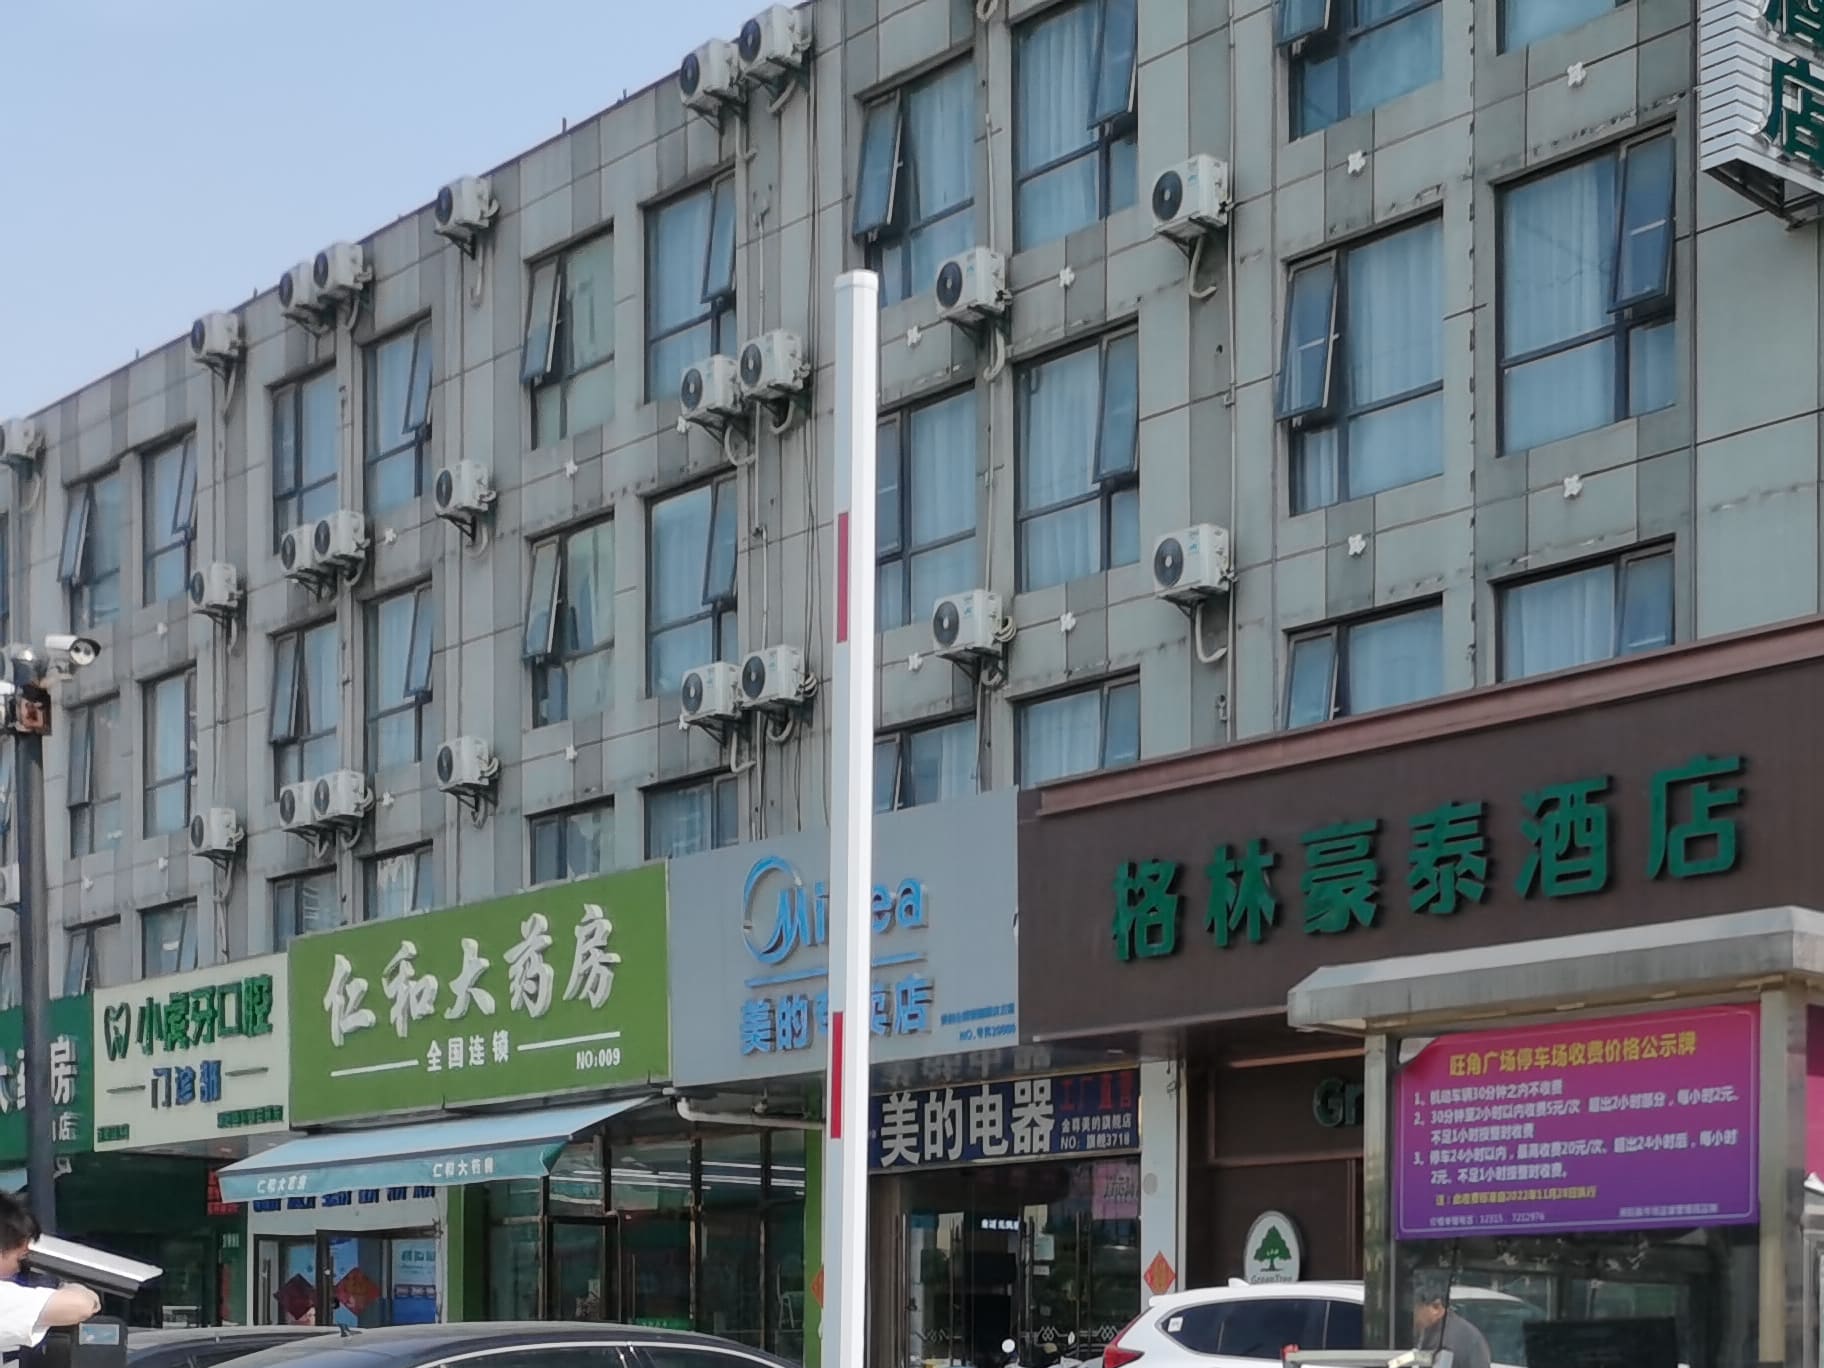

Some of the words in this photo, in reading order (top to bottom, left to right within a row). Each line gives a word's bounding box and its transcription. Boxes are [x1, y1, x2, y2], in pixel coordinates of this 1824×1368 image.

[1110, 754, 1748, 962] 格林豪泰酒店
[743, 857, 927, 963] Miea
[322, 902, 624, 1048] 仁和大药房
[426, 1030, 511, 1073] 全国连锁
[1449, 1031, 1697, 1077] 旺角广场停车场收费价格公示牌
[880, 1079, 1055, 1168] 美的电器
